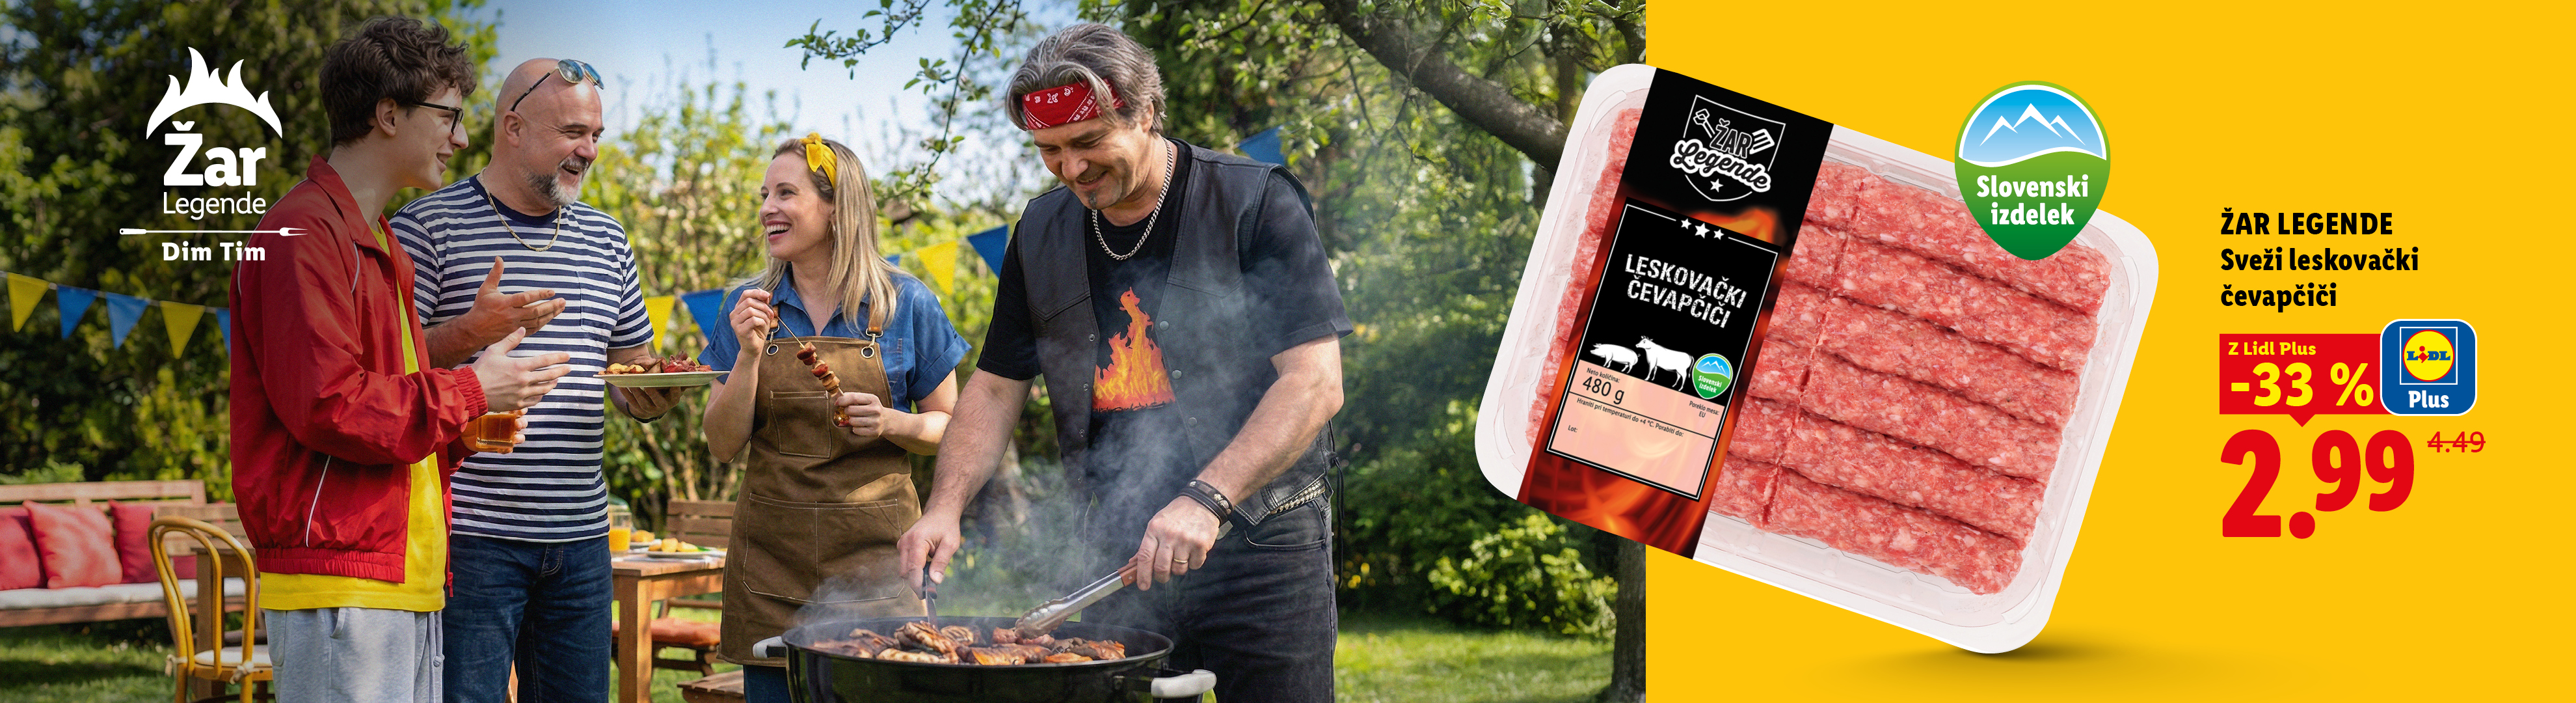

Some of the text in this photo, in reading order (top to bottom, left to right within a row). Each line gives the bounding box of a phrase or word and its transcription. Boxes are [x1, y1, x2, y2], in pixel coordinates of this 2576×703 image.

[1710, 118, 1752, 159] ŽAR
[1670, 139, 1771, 191] Legende
[1625, 253, 1747, 309] LESKOVAČKI
[1627, 274, 1731, 328] ČEVAPČIČI
[2228, 340, 2316, 355] Z Lidl Plus
[1587, 367, 1620, 383] Neto količina:
[1698, 375, 1723, 387] Slovenski
[1698, 382, 1717, 393] izdelek
[2231, 362, 2374, 407] -33 %
[1582, 376, 1625, 405] 480 g
[1577, 397, 1594, 407] Hraniti
[1602, 406, 1631, 420] temperaturi
[1655, 422, 1674, 434] Porabiti
[1689, 400, 1720, 415] Poreklo mesa:
[1568, 424, 1577, 433] Lot:
[2427, 431, 2486, 453] 4.49
[2220, 429, 2415, 539] 2.99
